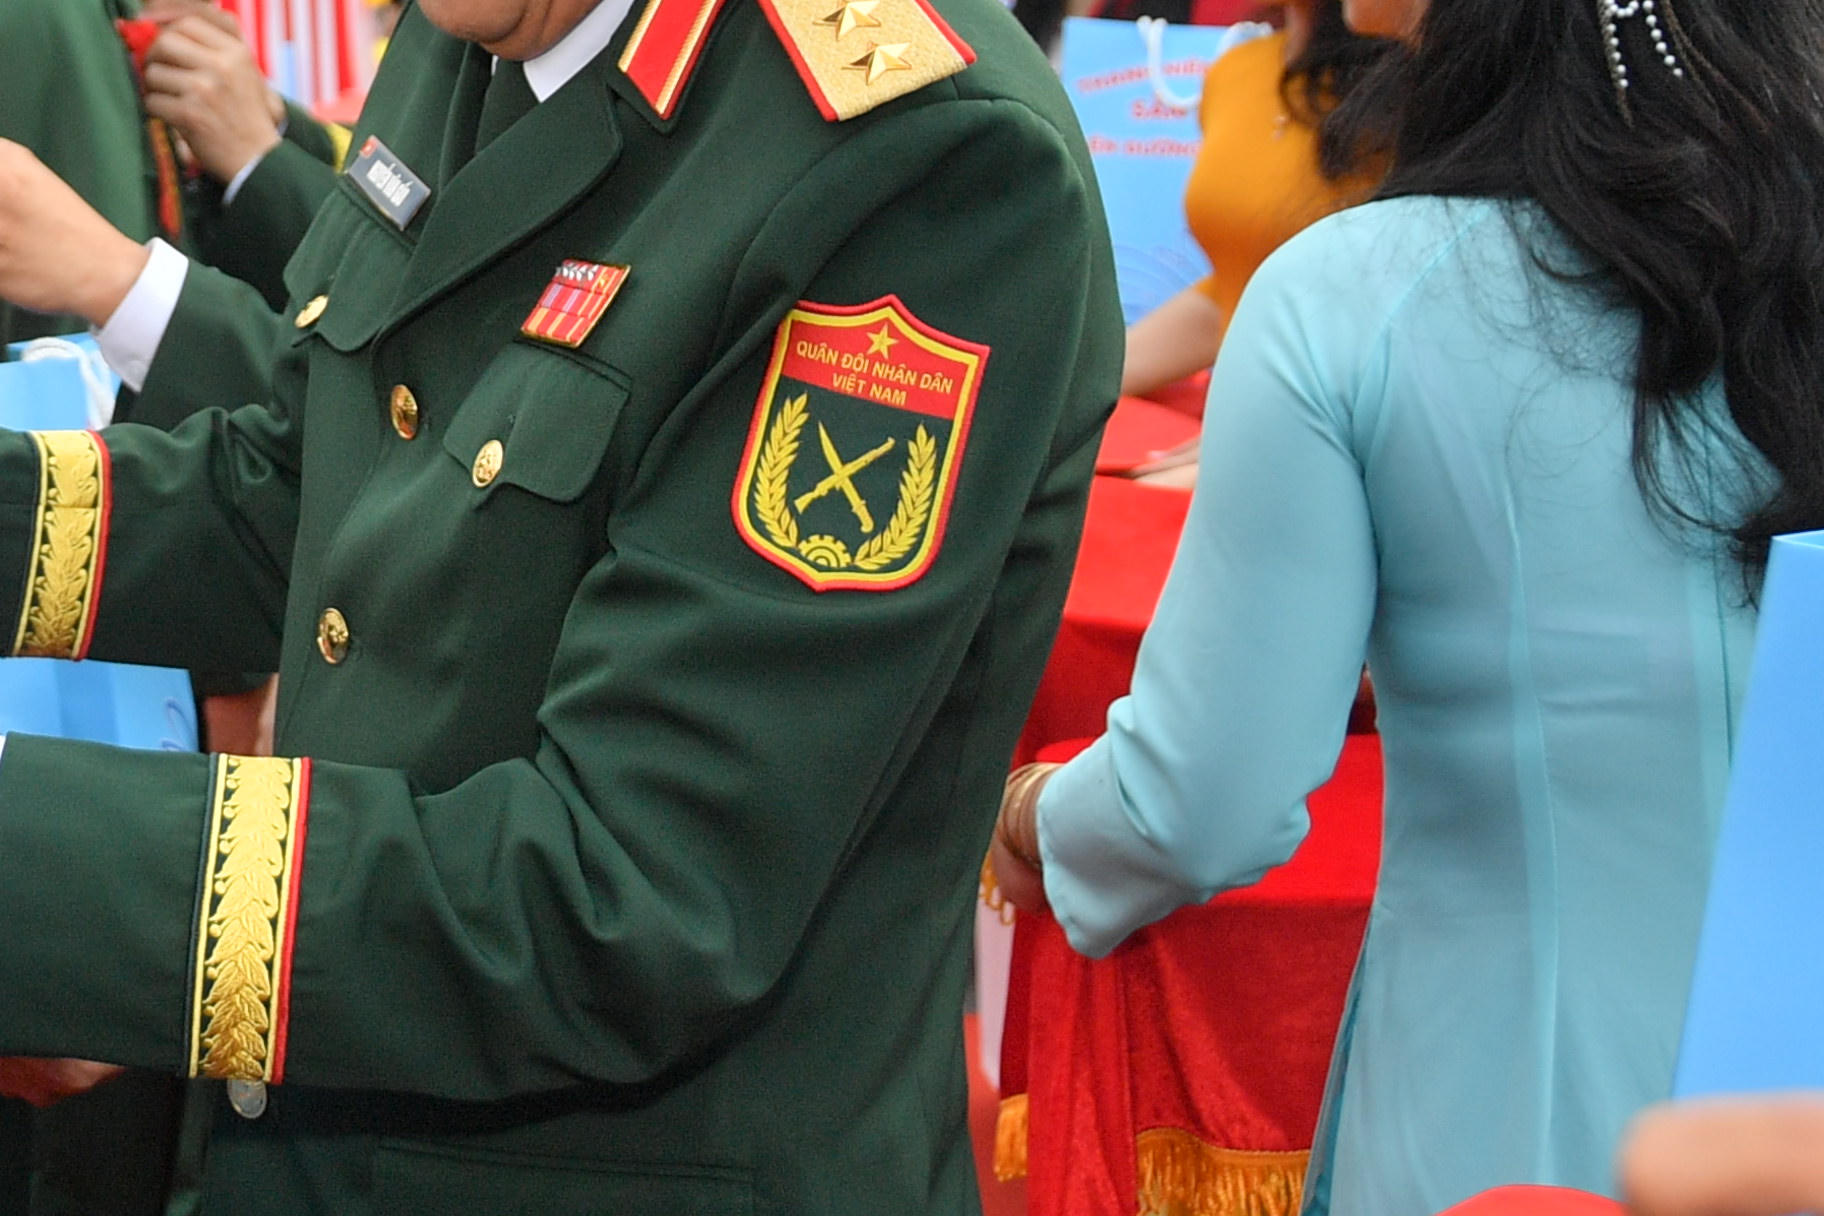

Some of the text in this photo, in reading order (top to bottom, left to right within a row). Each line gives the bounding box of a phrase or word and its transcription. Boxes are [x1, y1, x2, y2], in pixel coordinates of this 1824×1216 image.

[796, 340, 953, 395] QUÂN ĐỘI NHÂN DÂN
[832, 373, 907, 406] VIỆT NAM
